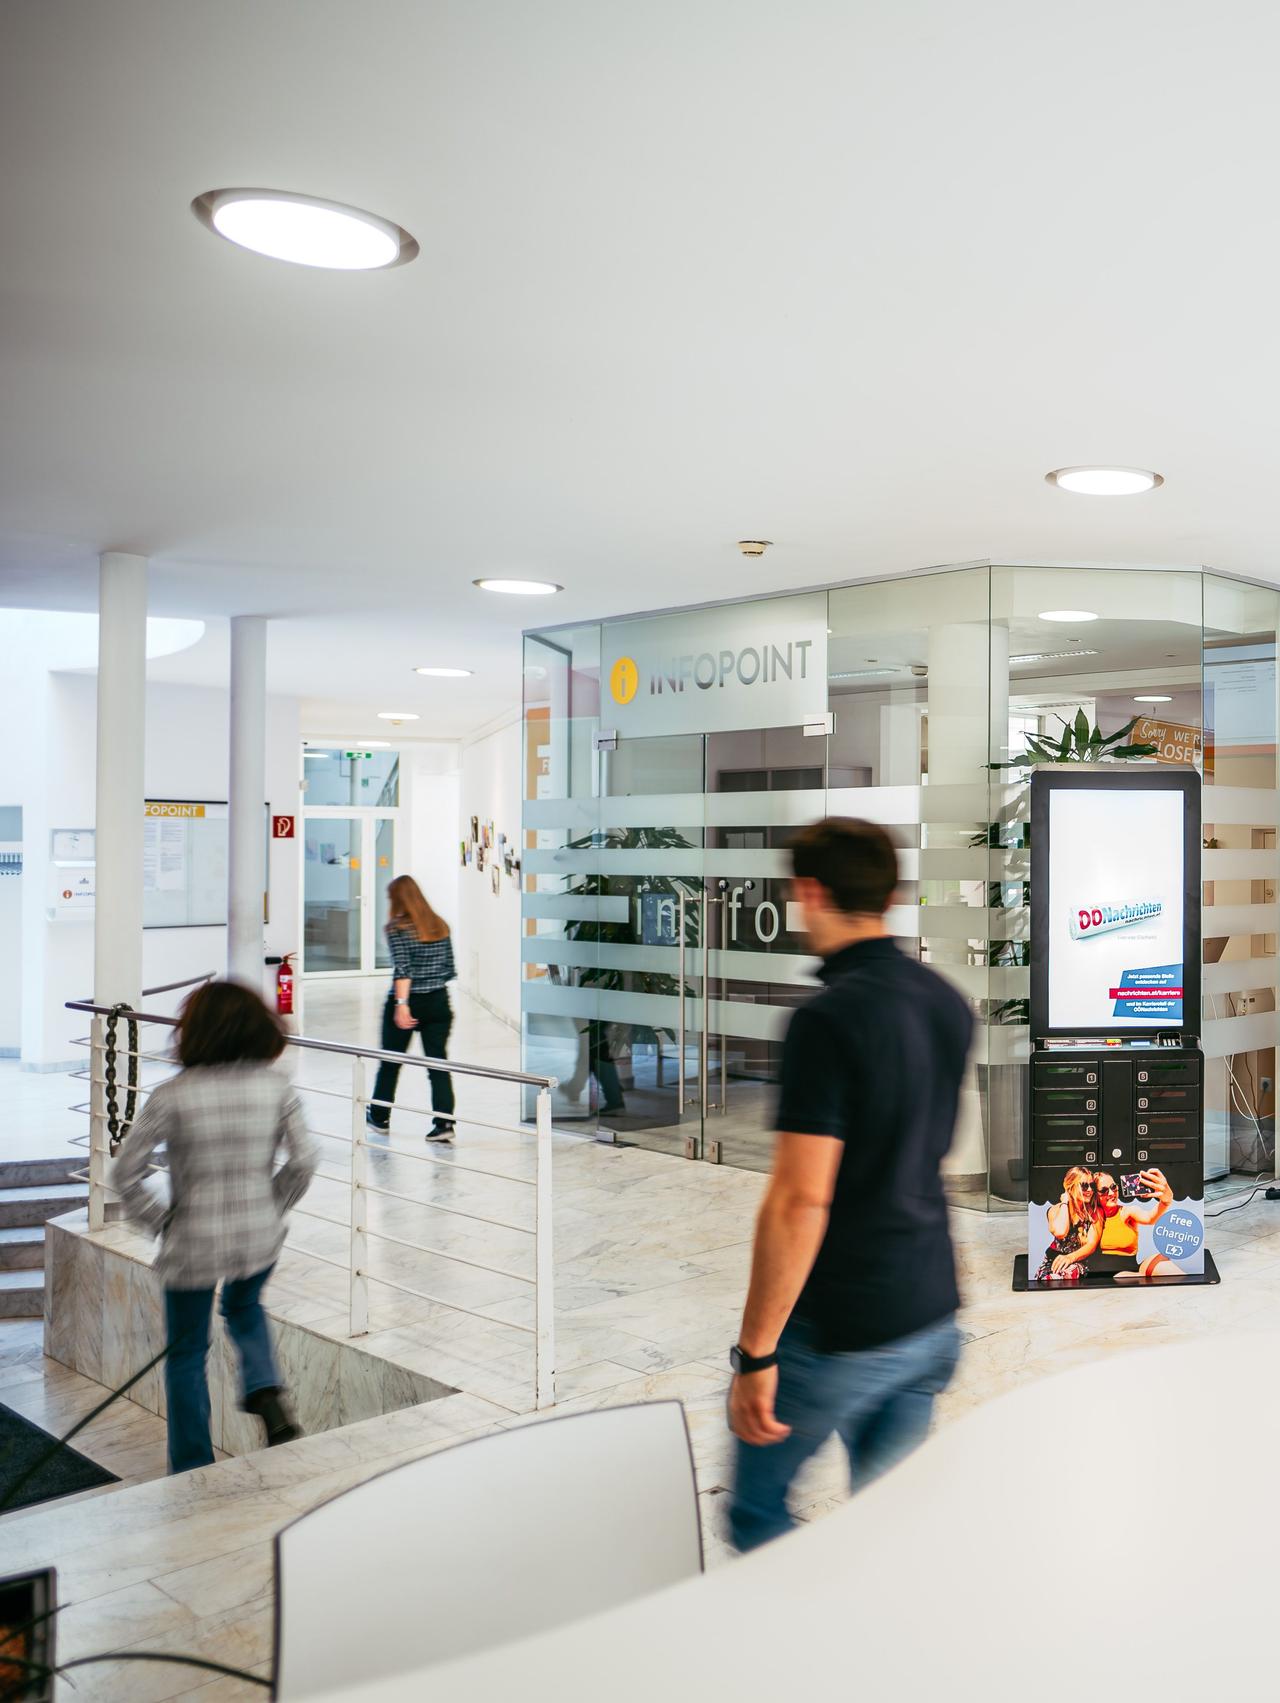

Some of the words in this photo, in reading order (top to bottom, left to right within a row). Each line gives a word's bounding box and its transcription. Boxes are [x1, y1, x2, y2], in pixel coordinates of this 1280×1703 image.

[650, 640, 813, 696] INFOPOINT
[1140, 721, 1167, 742] Sorry
[144, 804, 197, 817] FOPOINT
[1170, 1213, 1193, 1228] Free
[1155, 1225, 1200, 1246] Charging
